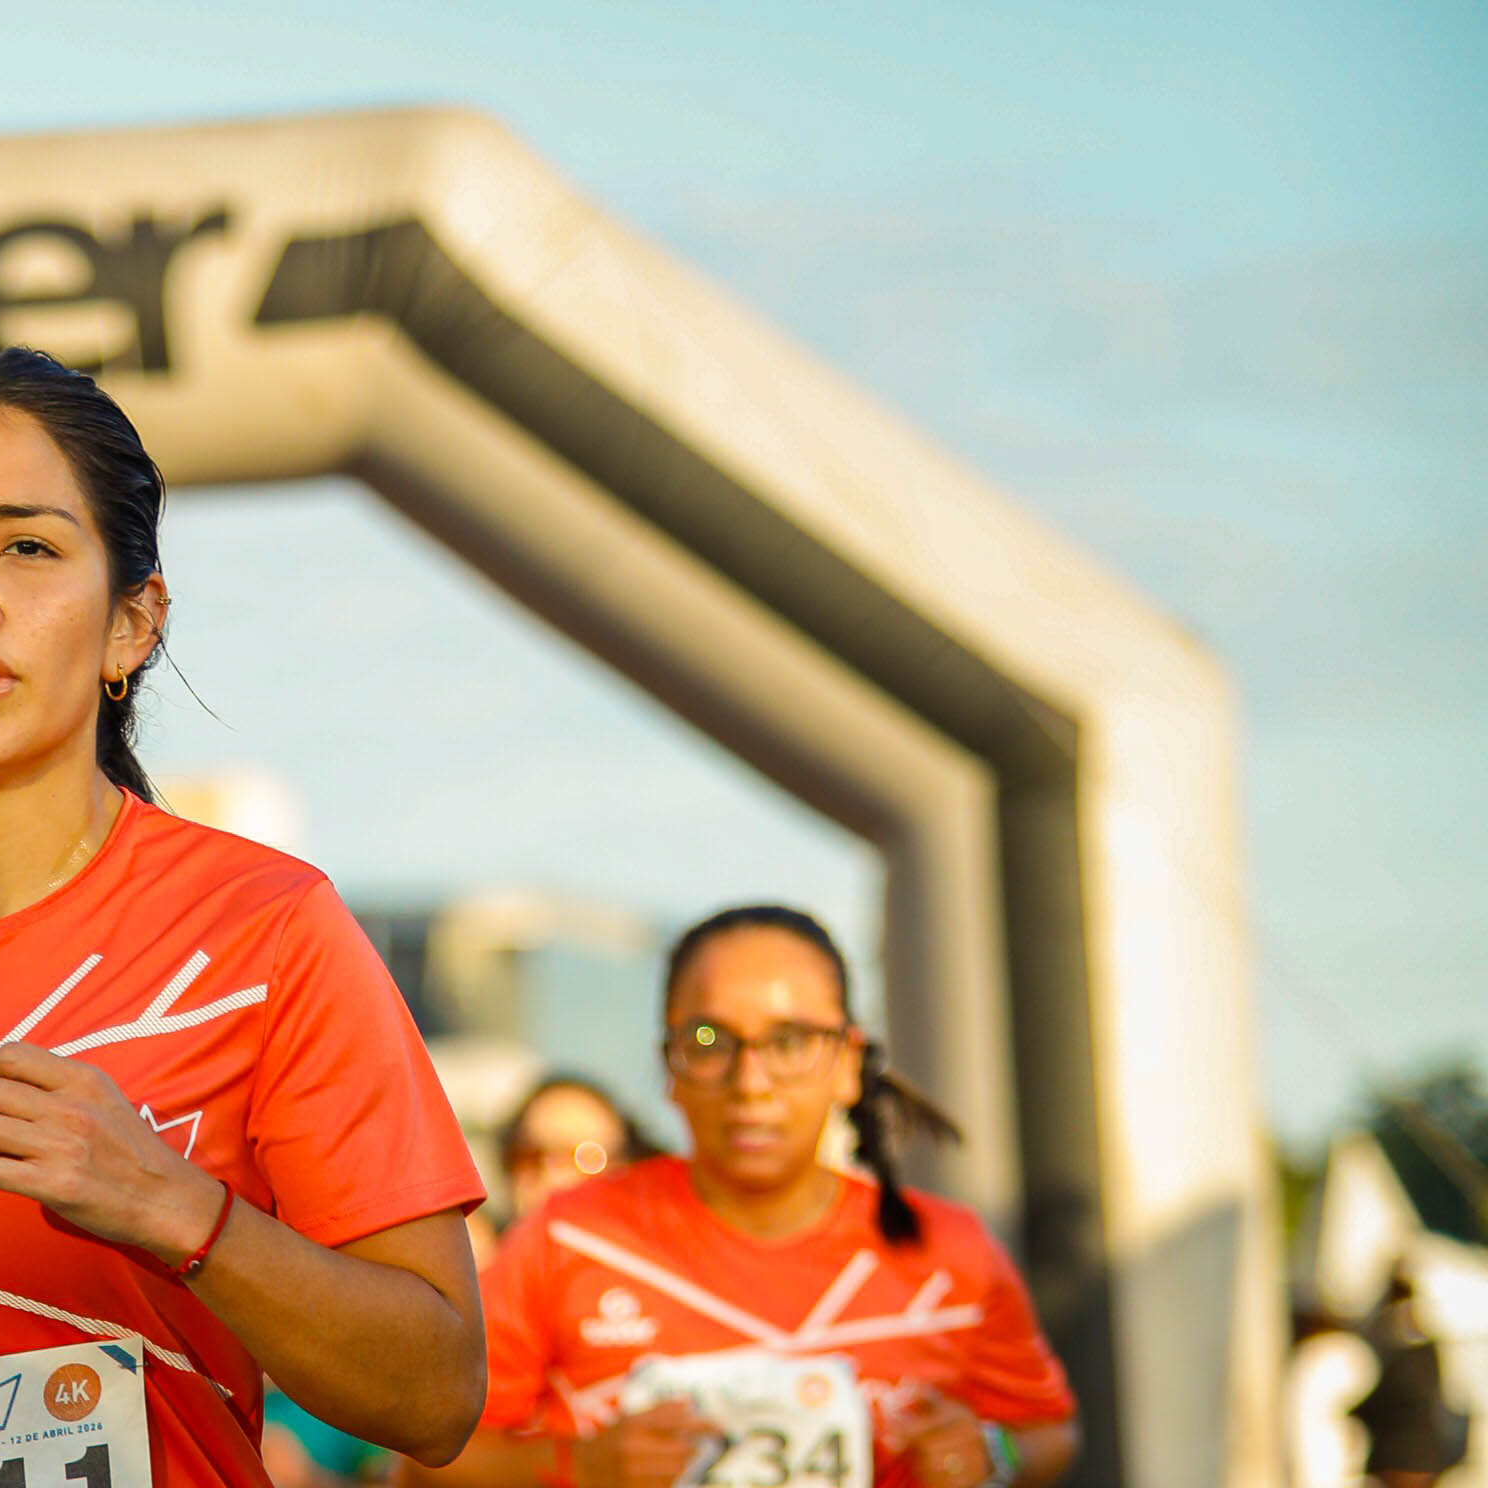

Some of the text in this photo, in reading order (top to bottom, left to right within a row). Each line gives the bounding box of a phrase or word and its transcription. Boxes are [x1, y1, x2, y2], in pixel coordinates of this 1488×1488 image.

[55, 1380, 89, 1404] 4K
[11, 1437, 22, 1445] 12
[26, 1432, 38, 1442] DE
[43, 1426, 73, 1439] ABRIL
[78, 1422, 103, 1433] 2026
